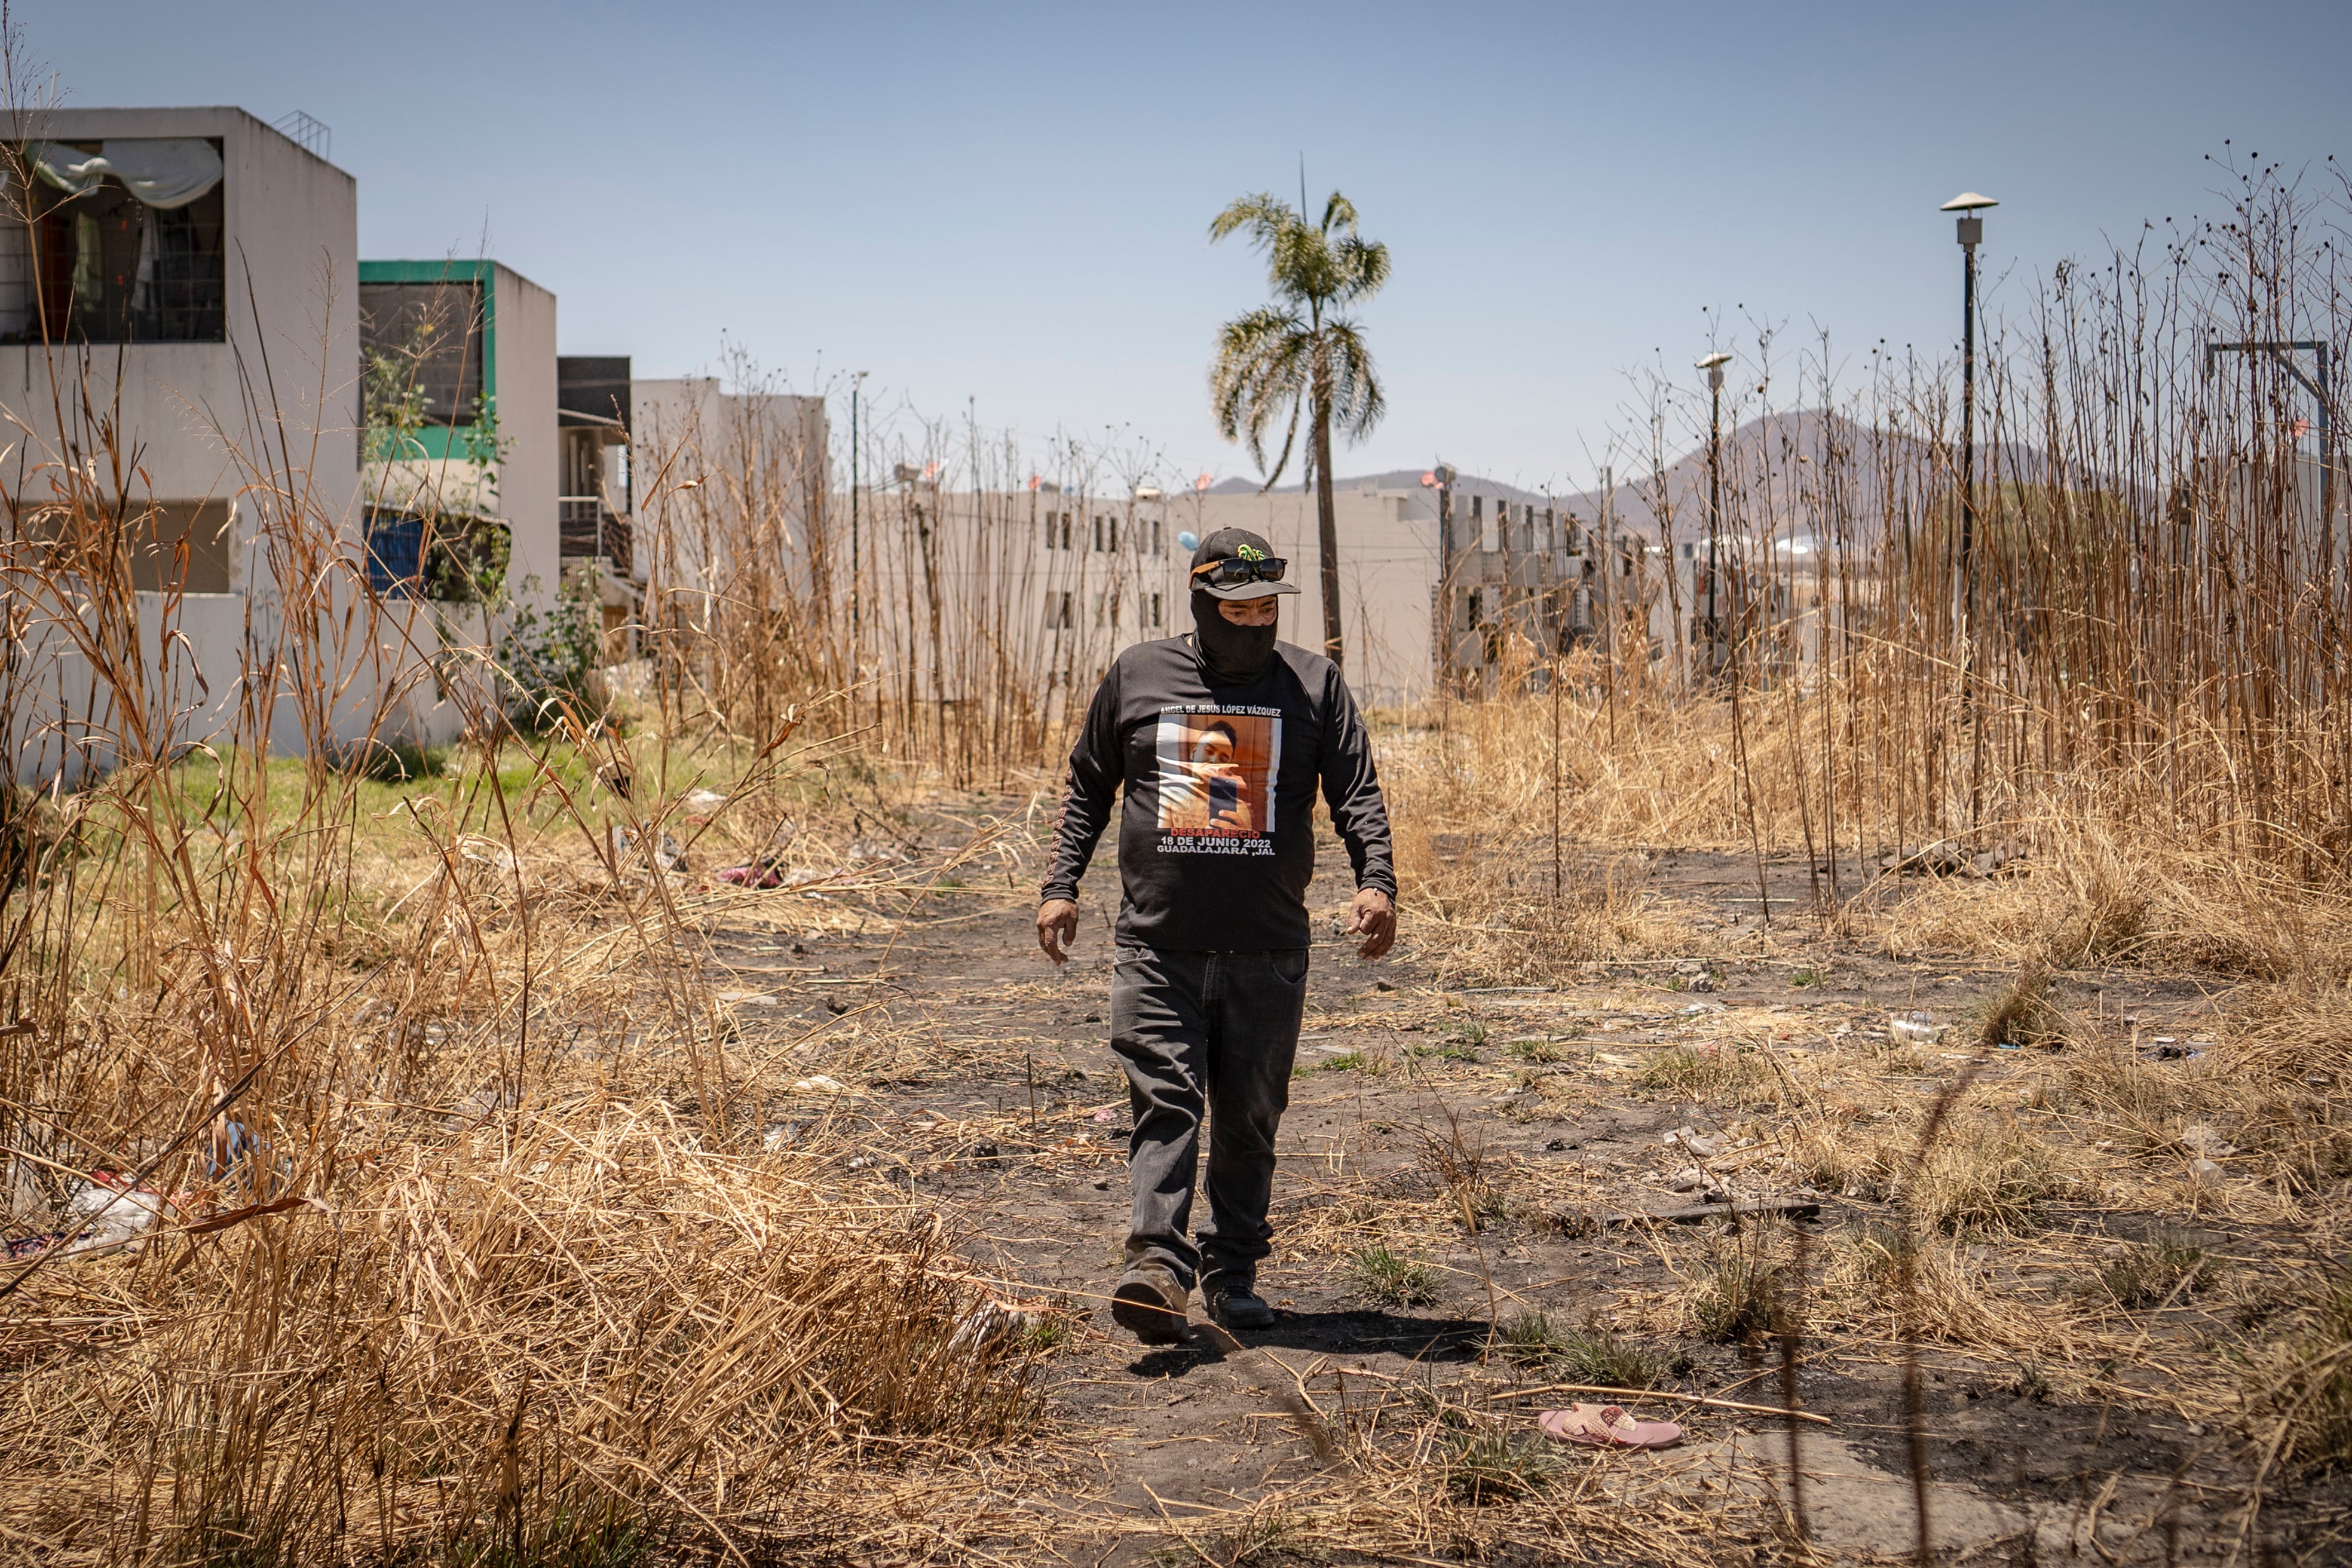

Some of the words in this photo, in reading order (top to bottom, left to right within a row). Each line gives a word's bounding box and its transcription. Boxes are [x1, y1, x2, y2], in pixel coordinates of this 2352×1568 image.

[1160, 705, 1184, 714] ANGEL
[1186, 705, 1196, 713] DE
[1222, 704, 1245, 714] LÓPEZ
[1247, 705, 1281, 717] VÁZQUEZ
[1171, 828, 1260, 839] DESAPARECIO
[1161, 837, 1174, 845] 18
[1177, 837, 1193, 846] DE
[1197, 837, 1239, 847] JUNIO
[1243, 838, 1270, 848] 2022
[1157, 845, 1249, 855] GUADALAJARA
